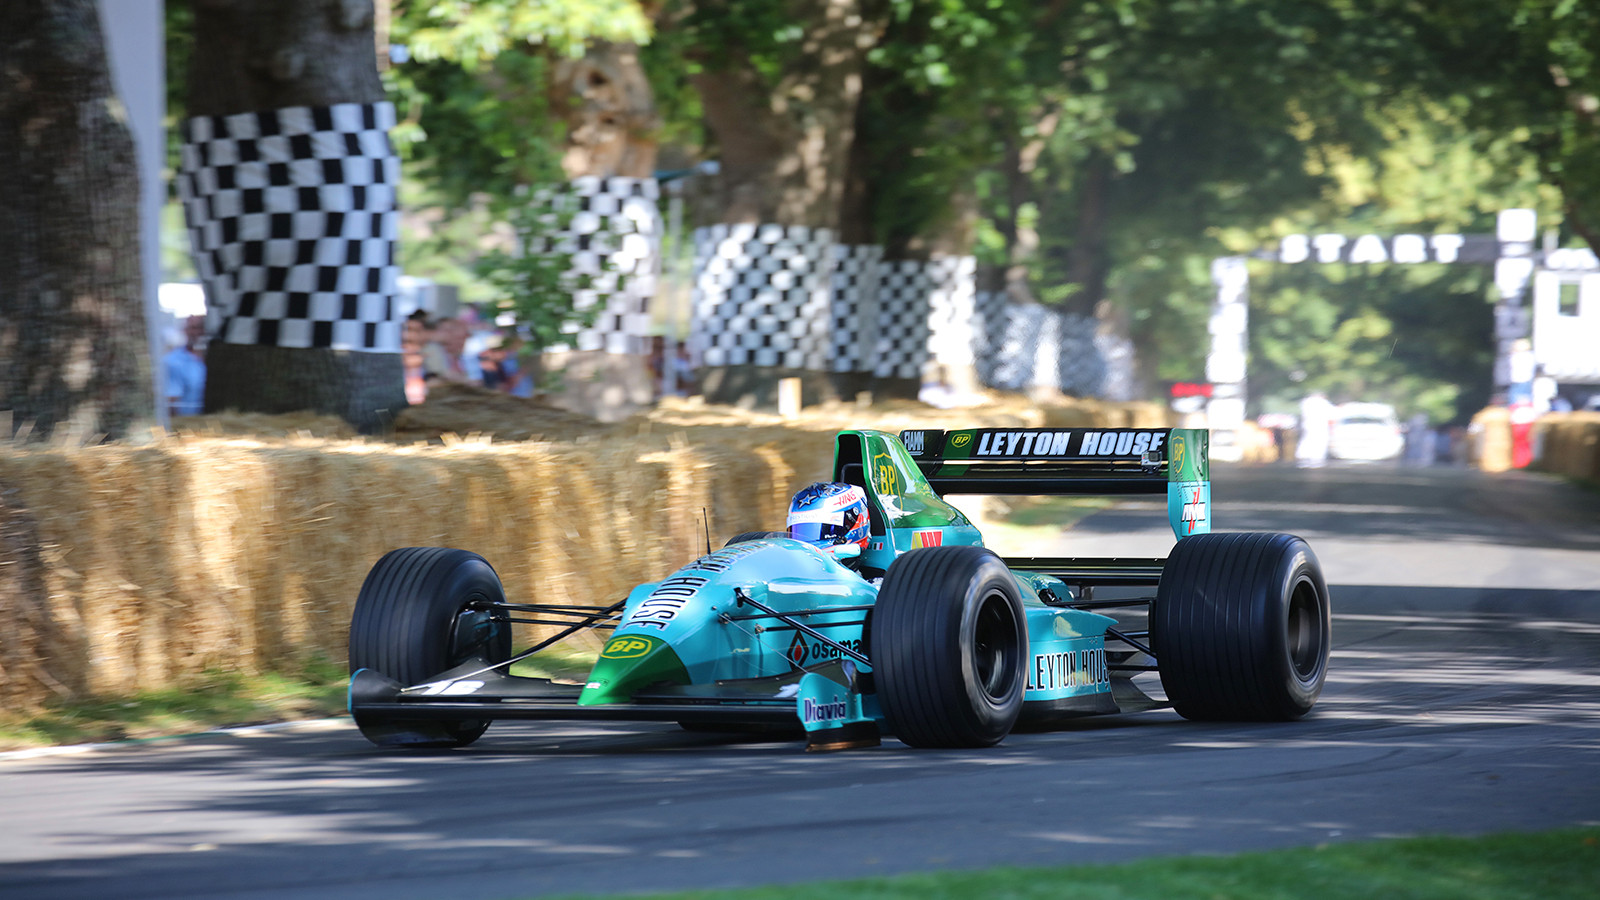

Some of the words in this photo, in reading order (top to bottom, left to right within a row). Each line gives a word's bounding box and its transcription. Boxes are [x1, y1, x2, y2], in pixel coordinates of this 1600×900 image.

[1279, 233, 1465, 264] START
[954, 436, 969, 444] BP
[976, 432, 1072, 456] LEYTON
[1078, 432, 1167, 456] HOUSE
[1174, 443, 1184, 461] BP
[879, 465, 896, 496] BP
[619, 576, 711, 632] HOUSE
[605, 640, 646, 654] BP
[804, 695, 847, 723] Diavia
